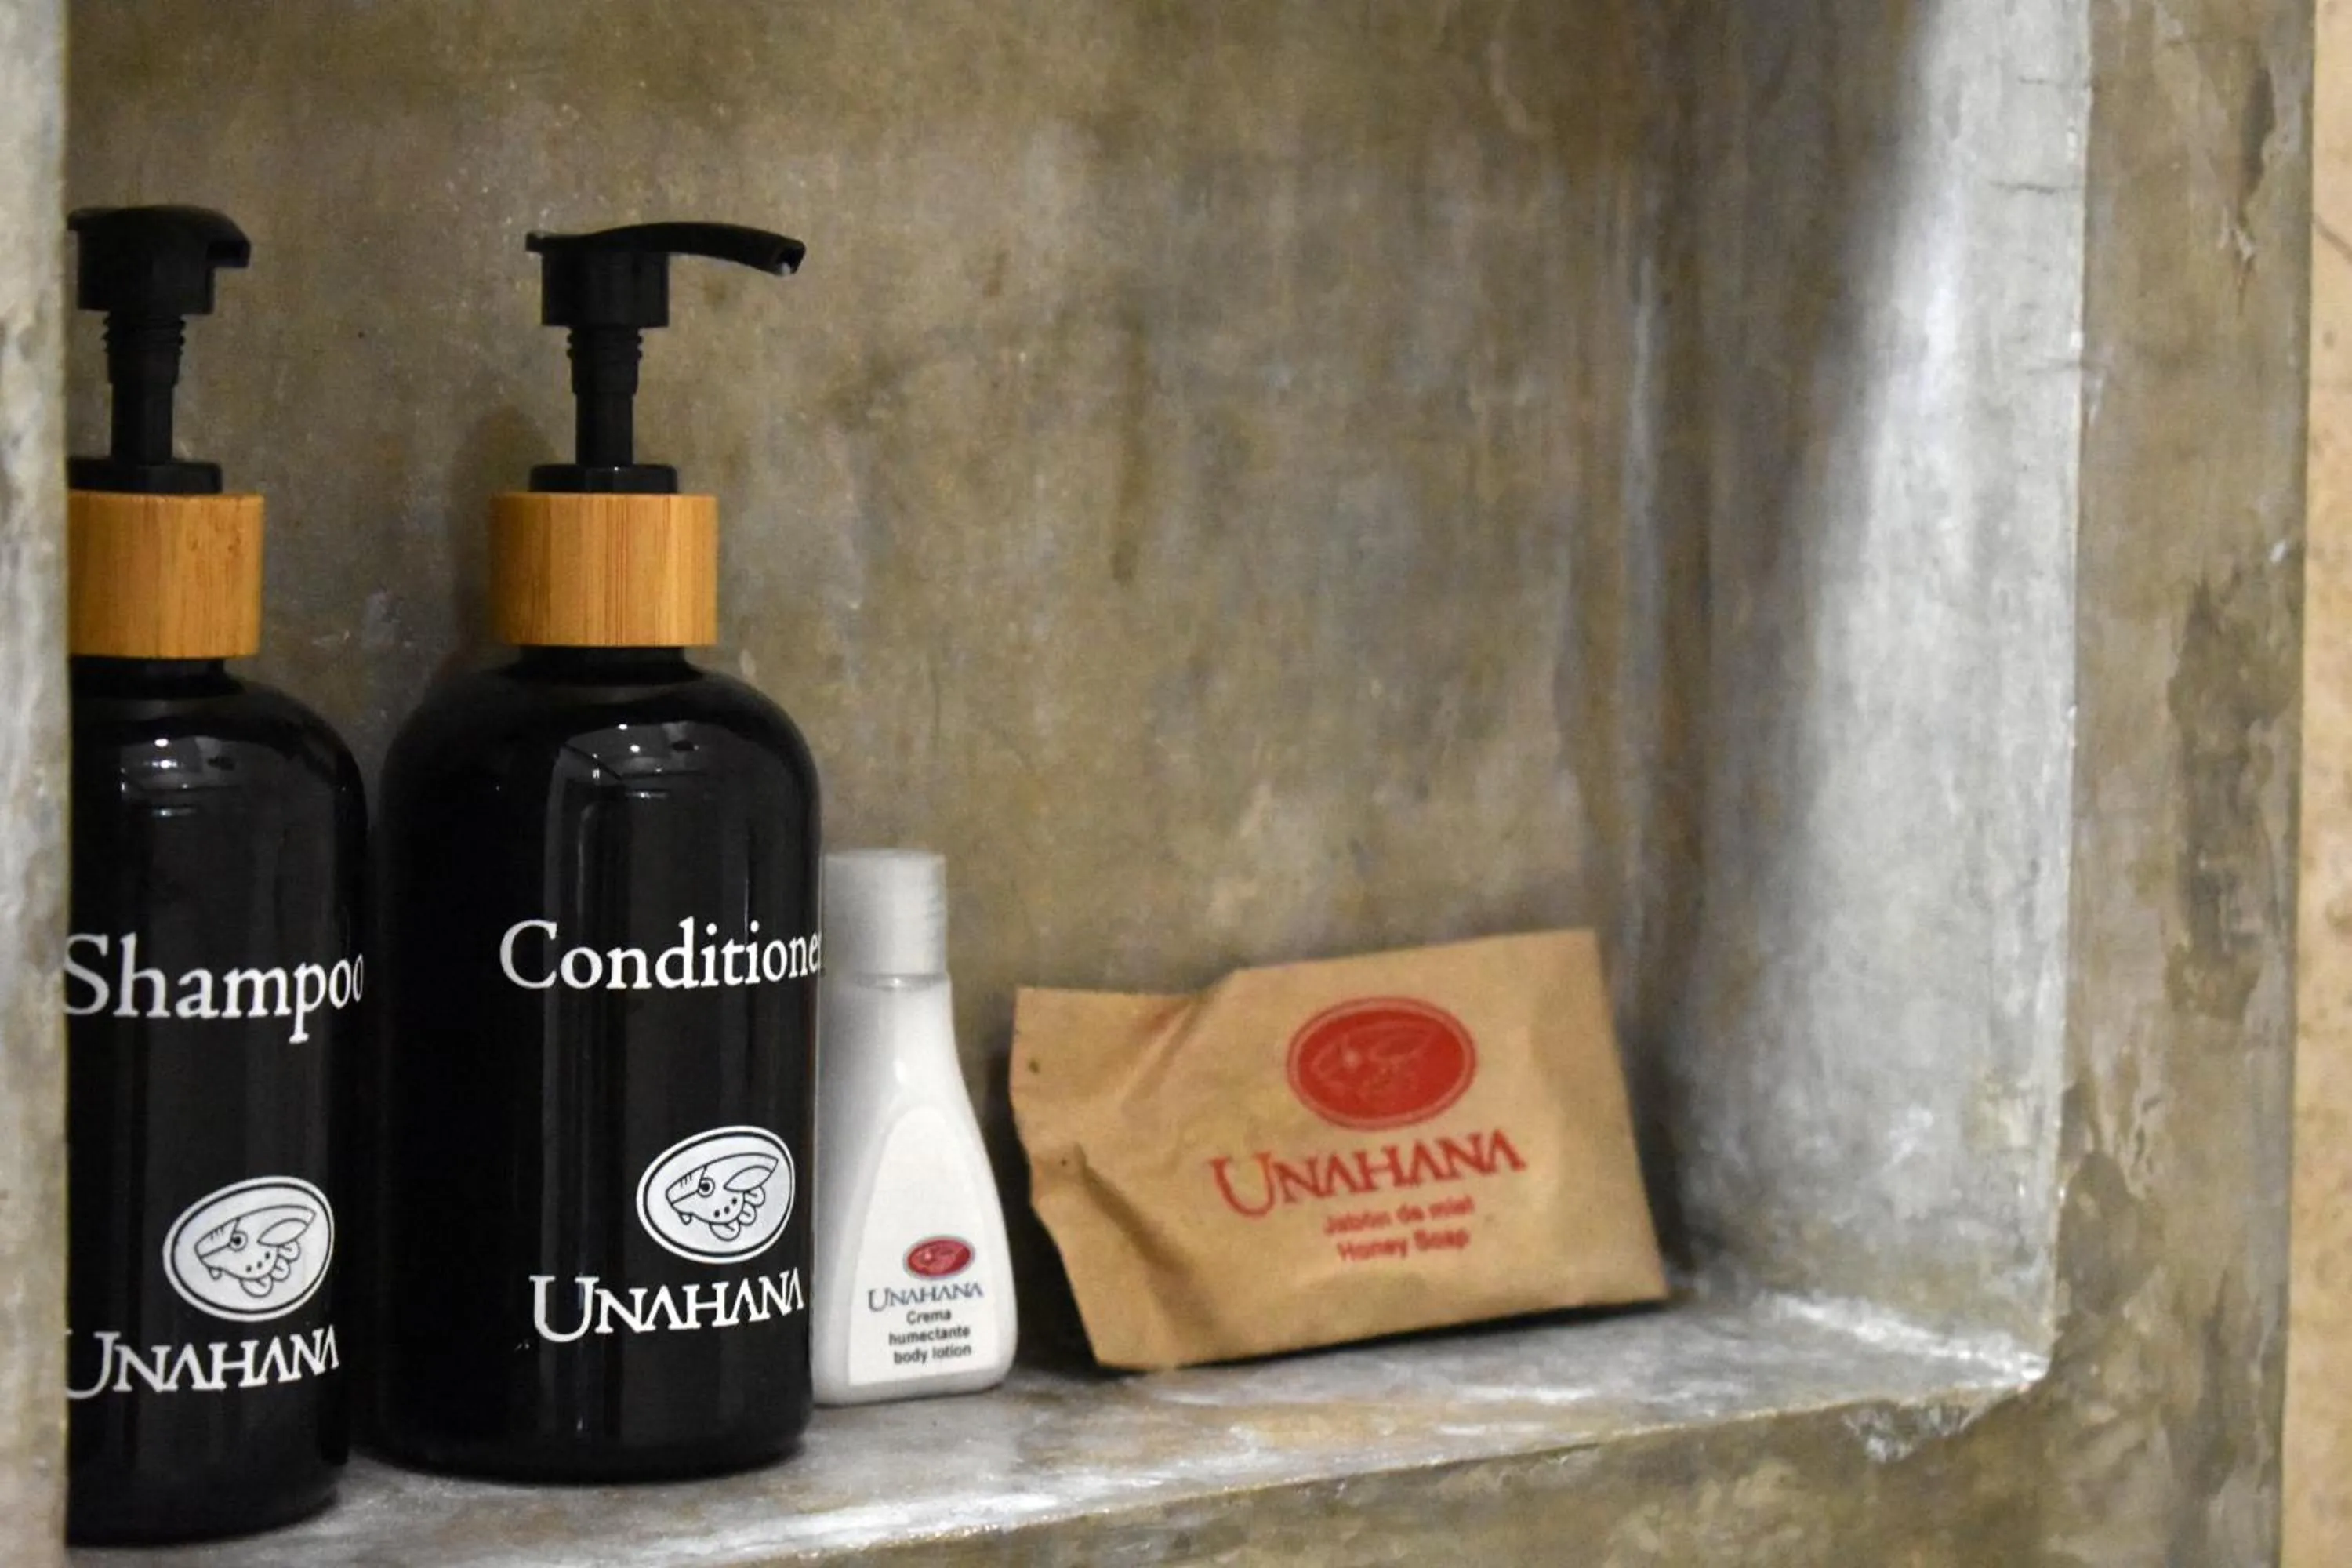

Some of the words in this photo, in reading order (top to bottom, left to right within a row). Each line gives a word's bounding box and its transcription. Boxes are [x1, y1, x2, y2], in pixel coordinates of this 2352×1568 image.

[499, 916, 821, 989] Conditione
[63, 932, 364, 1044] Shampoo
[1207, 1128, 1527, 1216] UNAHANA
[1396, 1202, 1425, 1223] de
[528, 1267, 804, 1343] UNAHANA
[867, 1282, 985, 1312] UNAHANA
[906, 1309, 952, 1324] Crema
[889, 1326, 971, 1346] humectante
[894, 1348, 927, 1365] body
[932, 1344, 972, 1359] lotion
